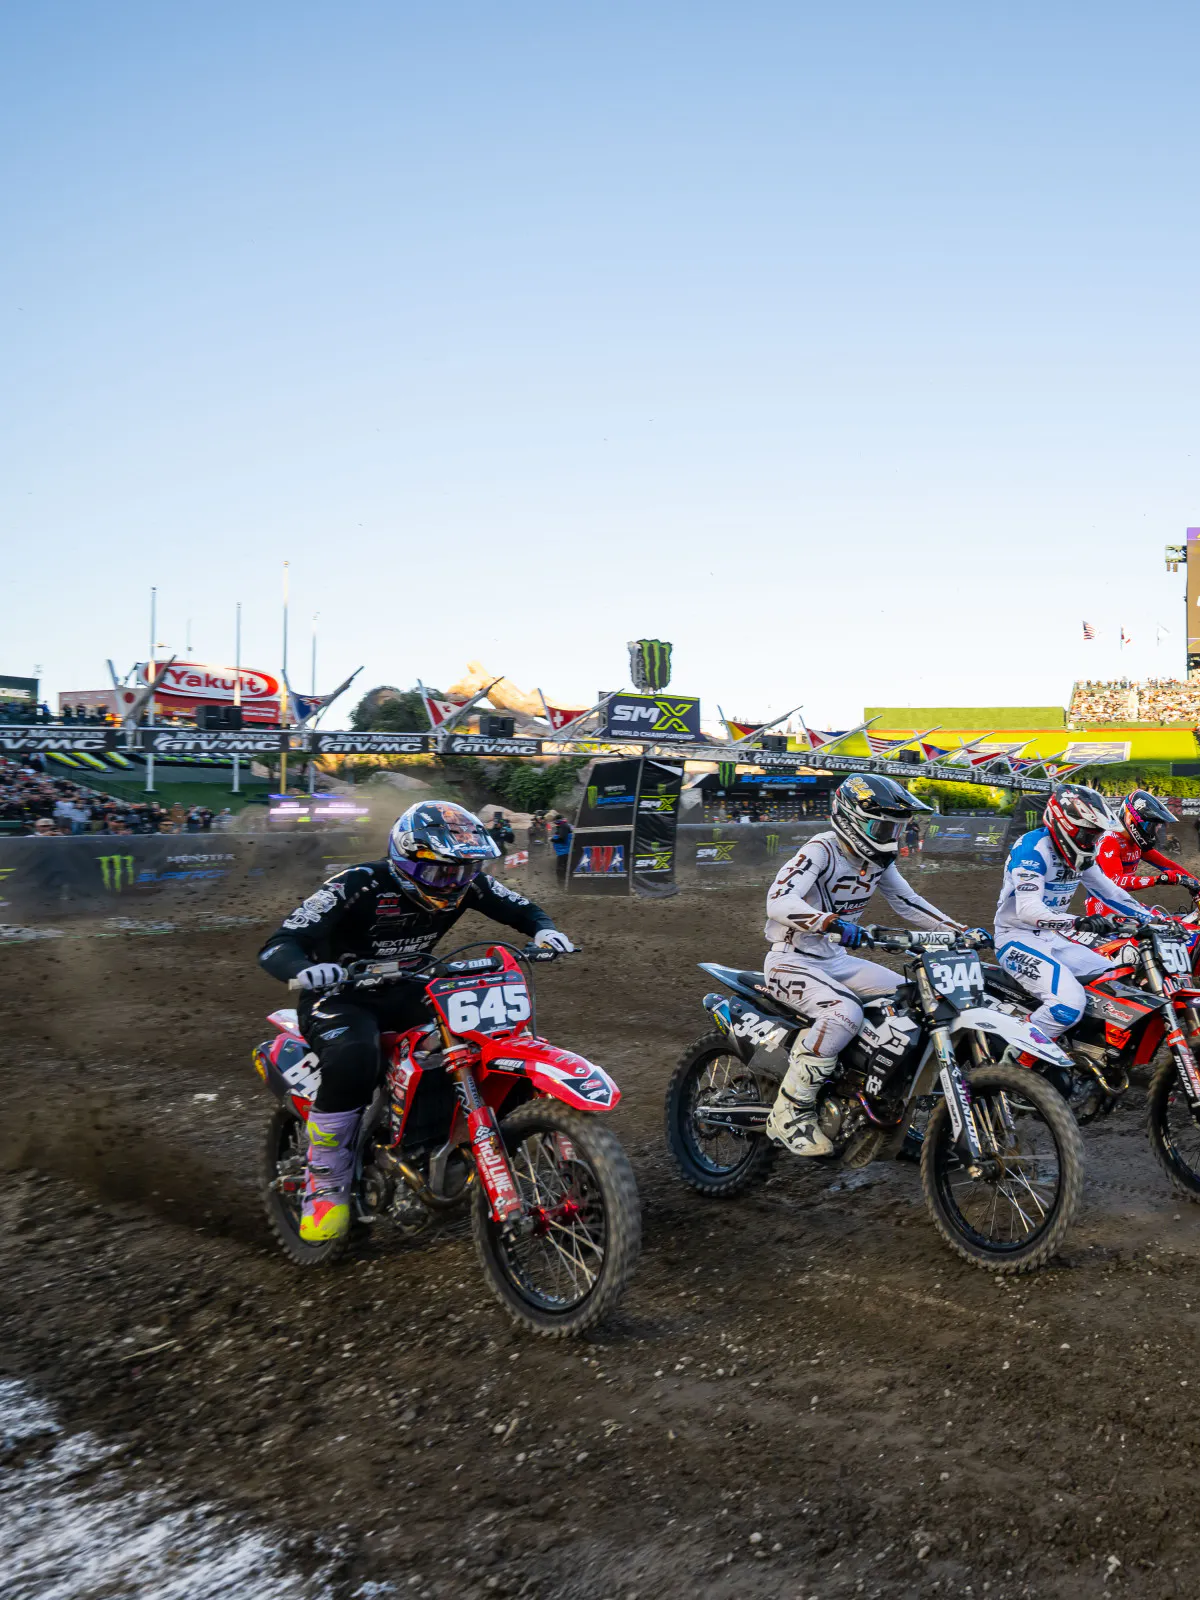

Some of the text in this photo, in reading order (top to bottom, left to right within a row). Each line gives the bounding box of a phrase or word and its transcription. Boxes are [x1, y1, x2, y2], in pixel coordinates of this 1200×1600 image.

[167, 668, 262, 693] Yakult
[611, 701, 694, 733] SMX
[611, 729, 696, 740] WORLD CHAMPIONSHIP
[640, 798, 677, 811] SMX
[166, 853, 236, 864] MONSTER
[575, 845, 626, 873] AMA
[635, 855, 671, 870] SMX
[696, 844, 735, 861] SMX
[372, 932, 438, 948] NEXT LEVEL
[375, 947, 397, 956] RED
[398, 944, 419, 954] LINE
[1161, 941, 1192, 974] 501
[933, 962, 984, 995] 344
[447, 984, 531, 1034] 645
[732, 1011, 789, 1053] 344
[282, 1051, 323, 1102] 64
[1174, 1055, 1195, 1098] DUNLOP
[955, 1082, 980, 1148] DUNLOP
[478, 1139, 513, 1197] RED LINE
